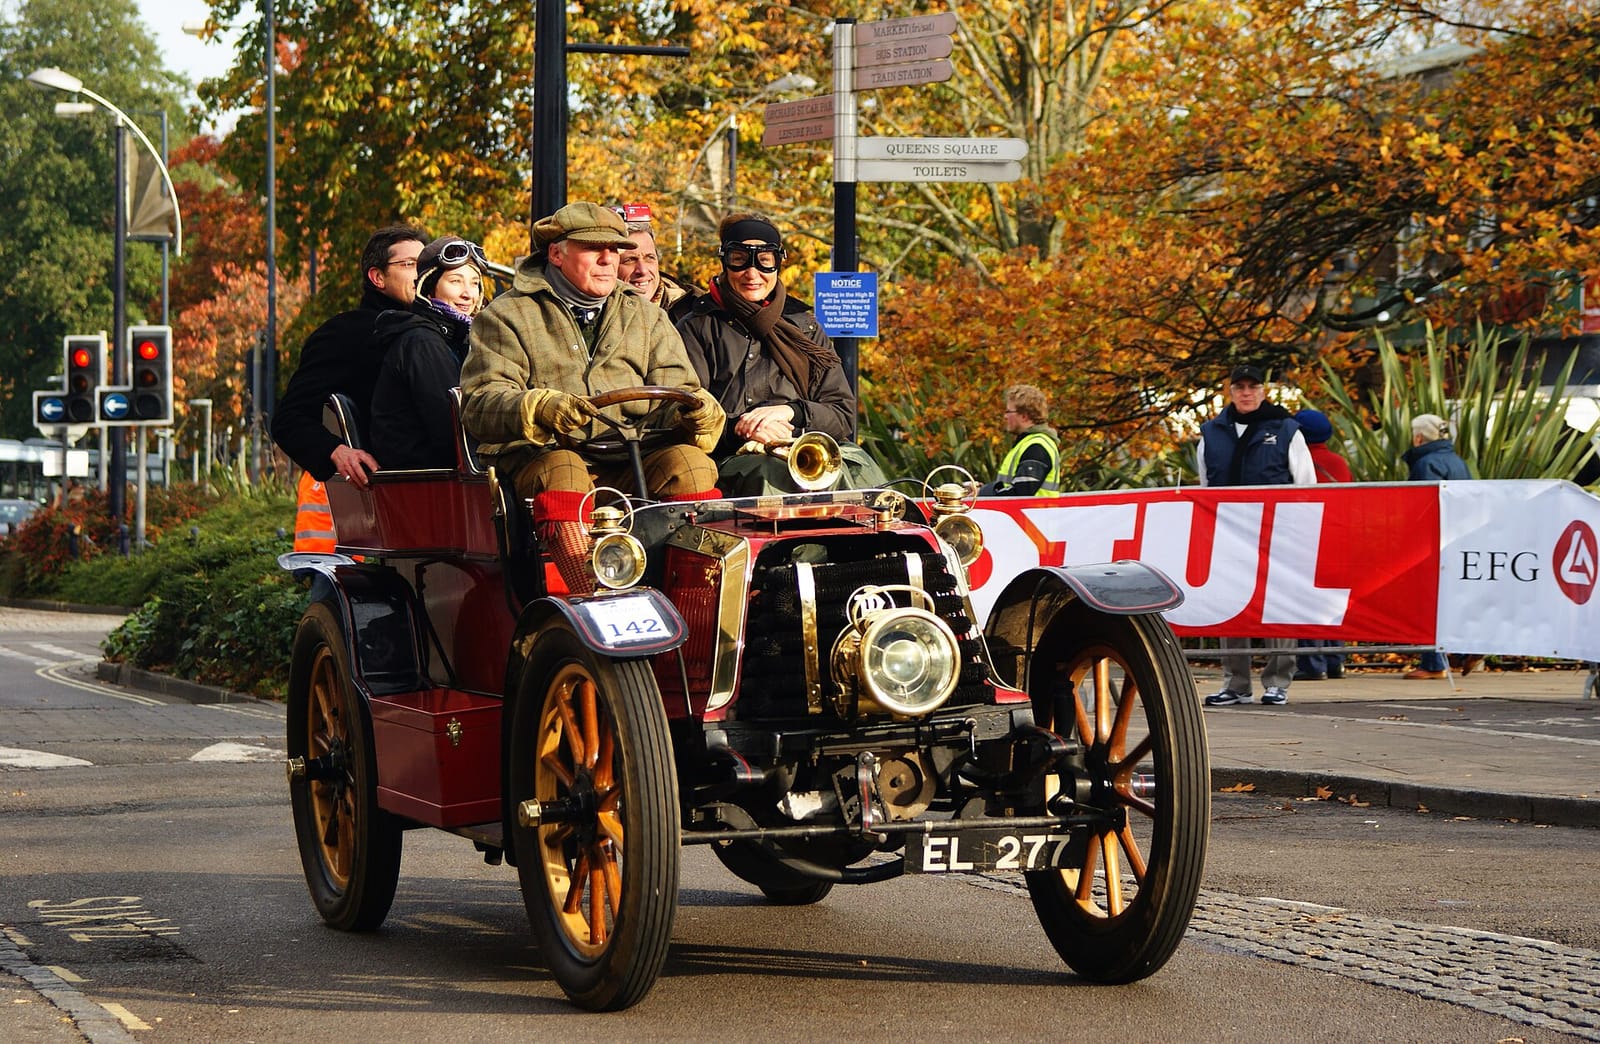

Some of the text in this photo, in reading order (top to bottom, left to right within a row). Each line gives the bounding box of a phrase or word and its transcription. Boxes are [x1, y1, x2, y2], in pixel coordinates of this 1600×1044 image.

[875, 44, 927, 60] BUS STATION
[872, 66, 932, 83] TRAIN STATION
[820, 101, 833, 113] PAR
[805, 124, 823, 136] PARK
[886, 143, 998, 155] QUEENS SQUARE
[913, 166, 968, 177] TOILETS
[831, 279, 862, 288] NOTICE
[1460, 551, 1540, 582] EFG
[607, 619, 662, 637] 142
[922, 834, 1071, 872] EL 277
[27, 896, 181, 942] TAXIS
